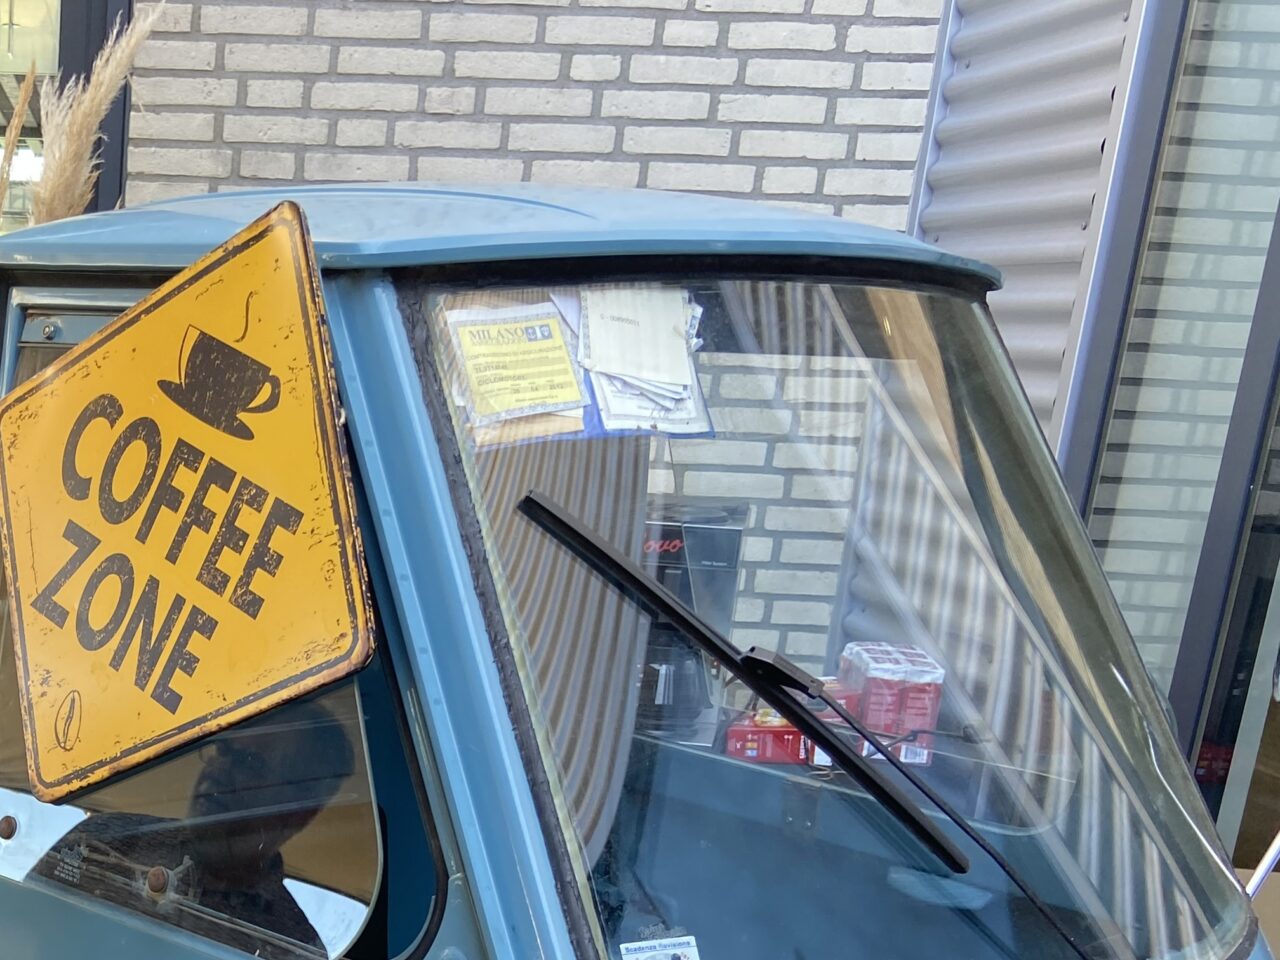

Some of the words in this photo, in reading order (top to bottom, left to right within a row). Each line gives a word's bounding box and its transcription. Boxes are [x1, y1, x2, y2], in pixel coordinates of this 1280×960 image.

[469, 327, 526, 341] MILANO
[61, 393, 304, 620] COFFEE
[30, 519, 219, 715] ZONE
